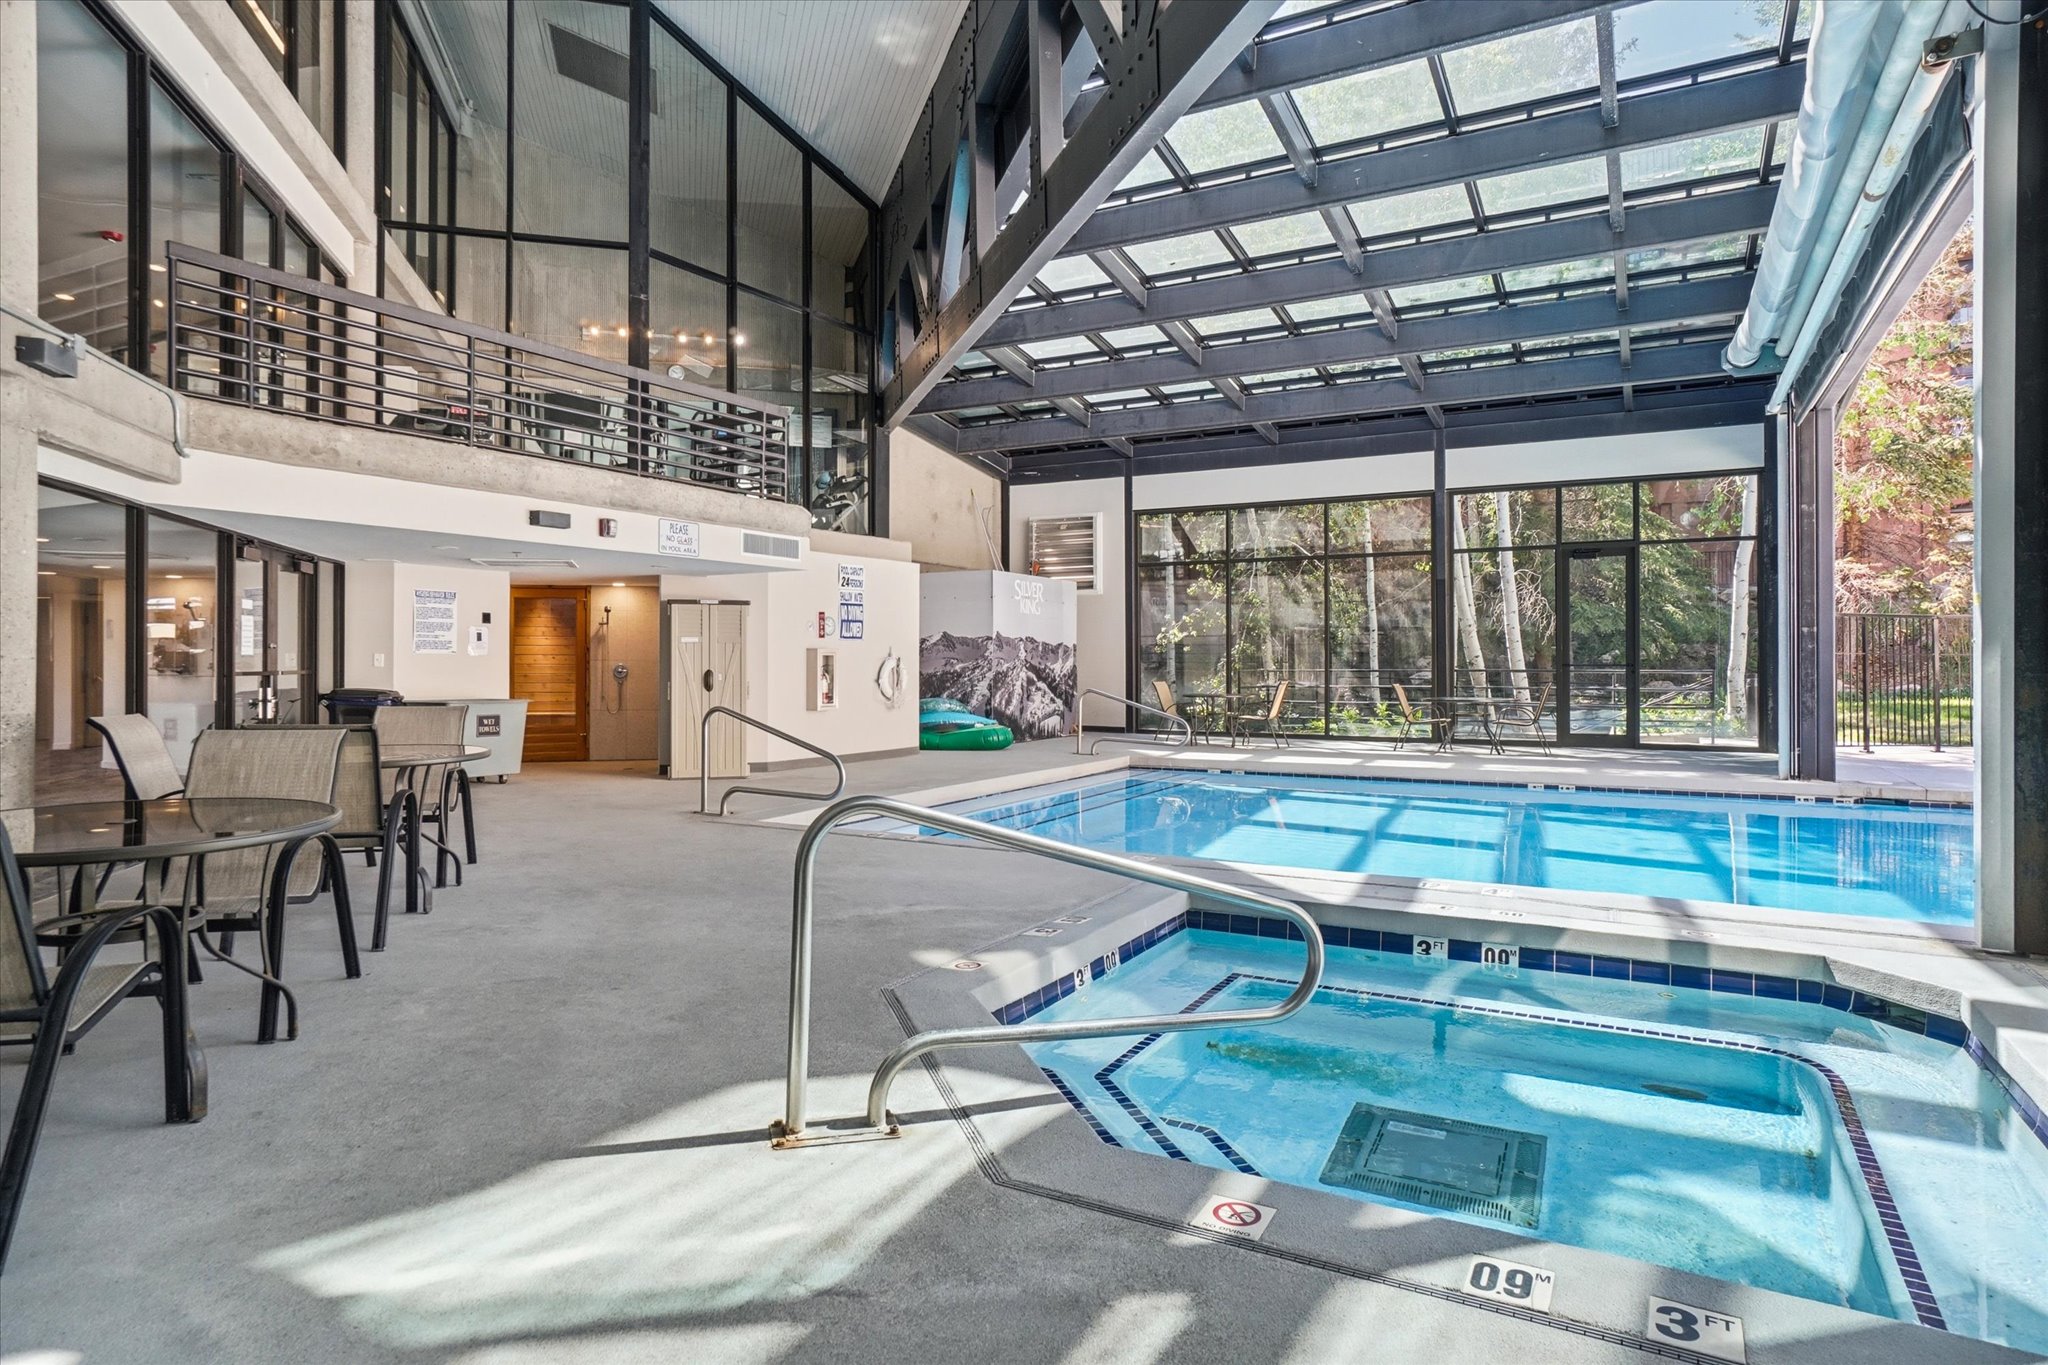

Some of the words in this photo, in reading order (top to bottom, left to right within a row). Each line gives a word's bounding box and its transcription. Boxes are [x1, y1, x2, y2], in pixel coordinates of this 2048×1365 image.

[669, 522, 689, 536] PLEASE
[666, 534, 676, 542] NO
[677, 536, 693, 545] GLASS
[661, 544, 668, 552] IN
[669, 545, 682, 553] POOL
[841, 576, 850, 588] 24
[1014, 579, 1044, 602] SILVER
[1020, 598, 1041, 615] KING
[841, 621, 863, 638] ALLOWED
[1416, 940, 1432, 956] 3
[1433, 942, 1445, 951] FT
[1509, 950, 1517, 958] M
[1076, 968, 1085, 987] 3
[1202, 1221, 1217, 1229] NO
[1218, 1225, 1251, 1237] DIVING
[1534, 1273, 1551, 1285] M
[1654, 1305, 1701, 1342] 3
[1704, 1314, 1736, 1333] FT
